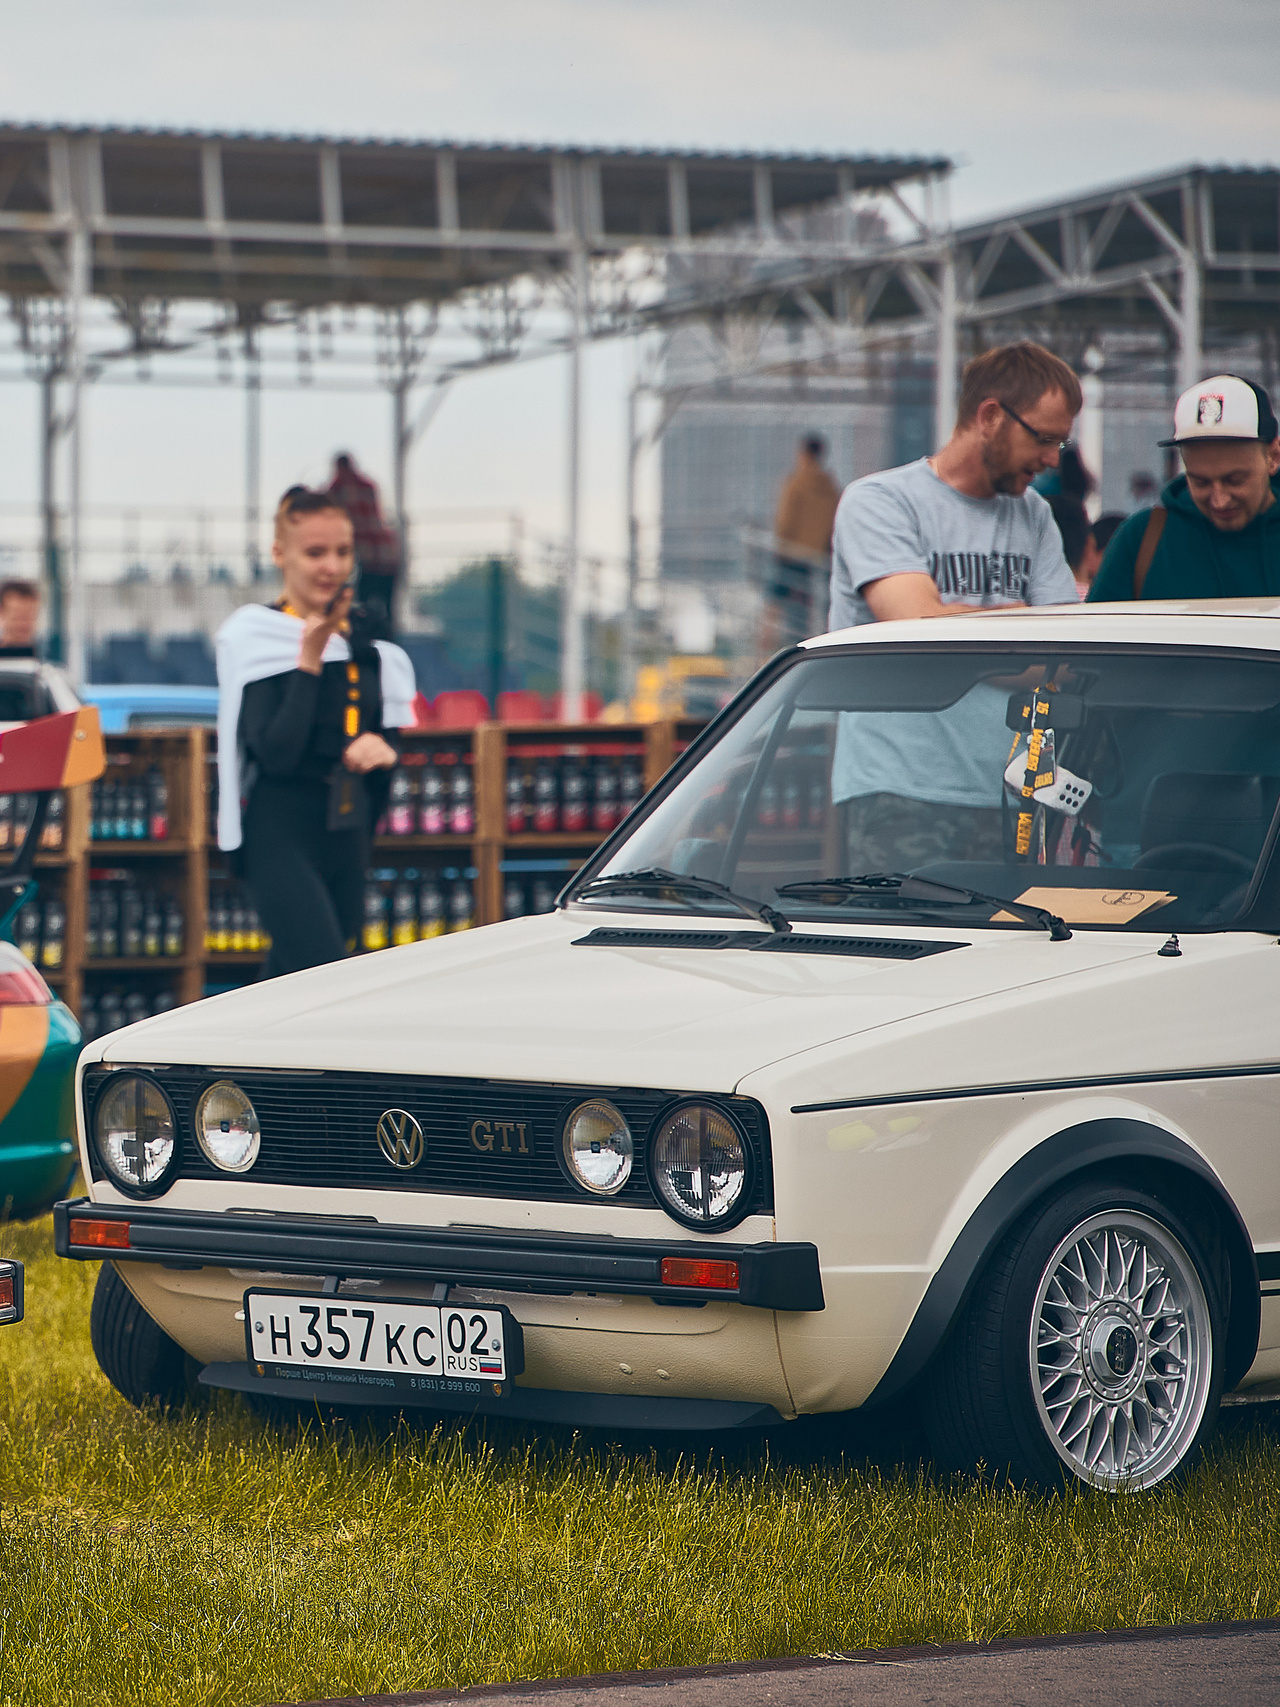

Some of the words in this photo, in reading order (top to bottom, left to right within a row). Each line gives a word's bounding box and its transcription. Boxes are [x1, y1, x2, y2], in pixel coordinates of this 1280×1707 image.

[471, 1119, 529, 1154] GTI
[447, 1312, 490, 1356] 02
[447, 1355, 478, 1372] RUS
[275, 1367, 301, 1380] Порше
[302, 1370, 325, 1383] Центр
[326, 1371, 358, 1384] Нижний
[358, 1374, 396, 1388] Новгород
[410, 1379, 417, 1388] 8
[418, 1379, 439, 1392] (831)
[439, 1380, 447, 1390] 2
[447, 1381, 464, 1392] 999
[465, 1382, 481, 1393] 600
